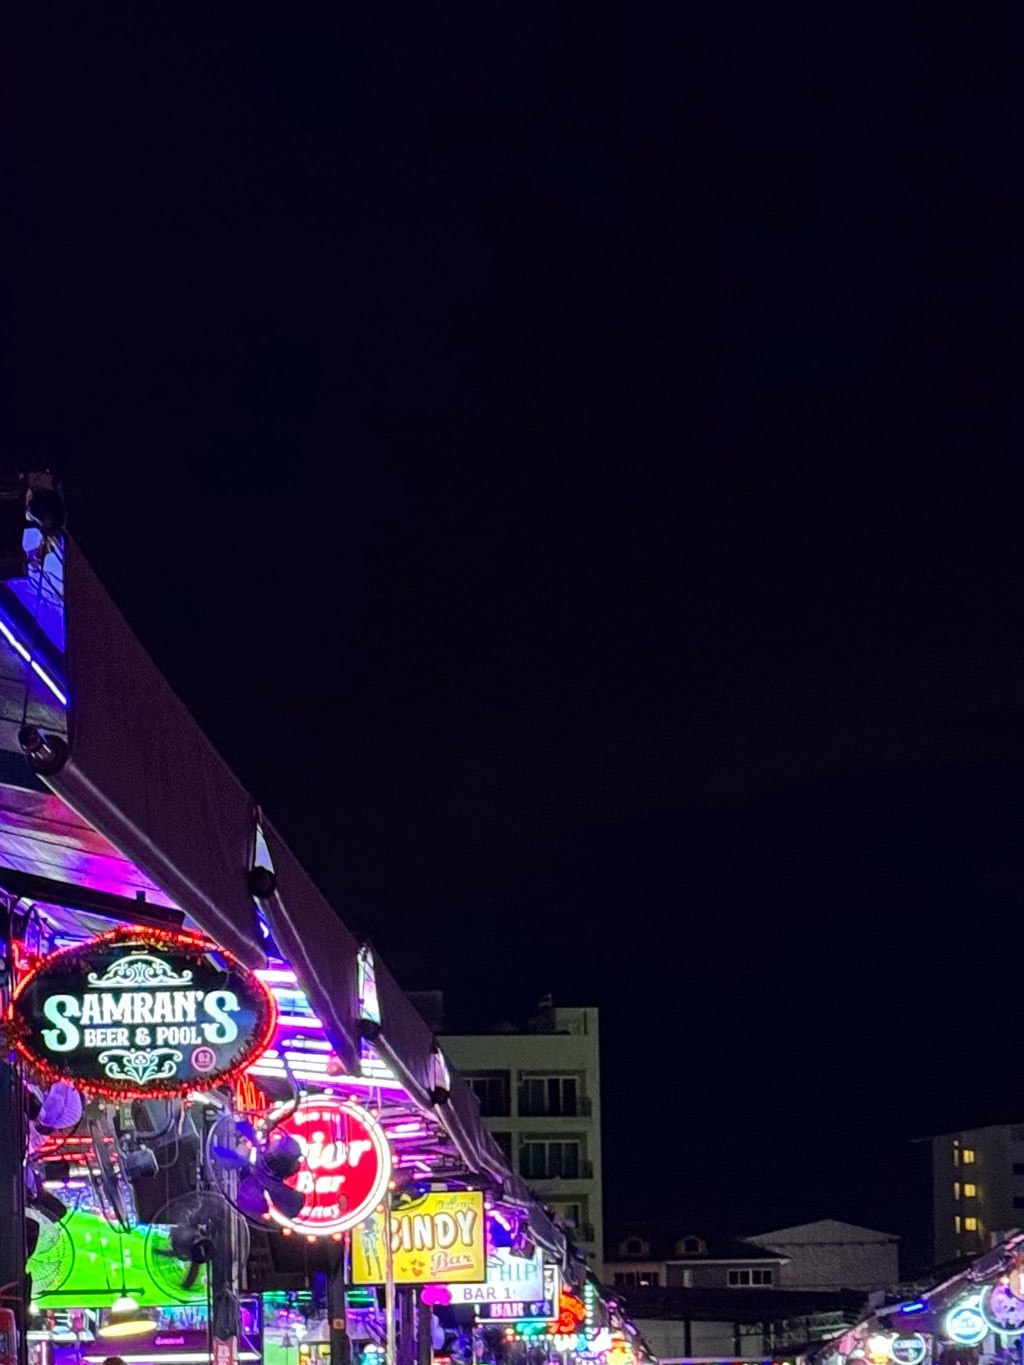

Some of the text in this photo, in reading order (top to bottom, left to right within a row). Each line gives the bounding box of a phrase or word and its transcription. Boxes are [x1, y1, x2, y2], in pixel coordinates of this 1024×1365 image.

[41, 991, 240, 1051] SAMRAN'S
[84, 1025, 202, 1047] BEER & POOL
[296, 1171, 346, 1193] Bar
[431, 1252, 473, 1271] Bar
[463, 1288, 496, 1300] BAR
